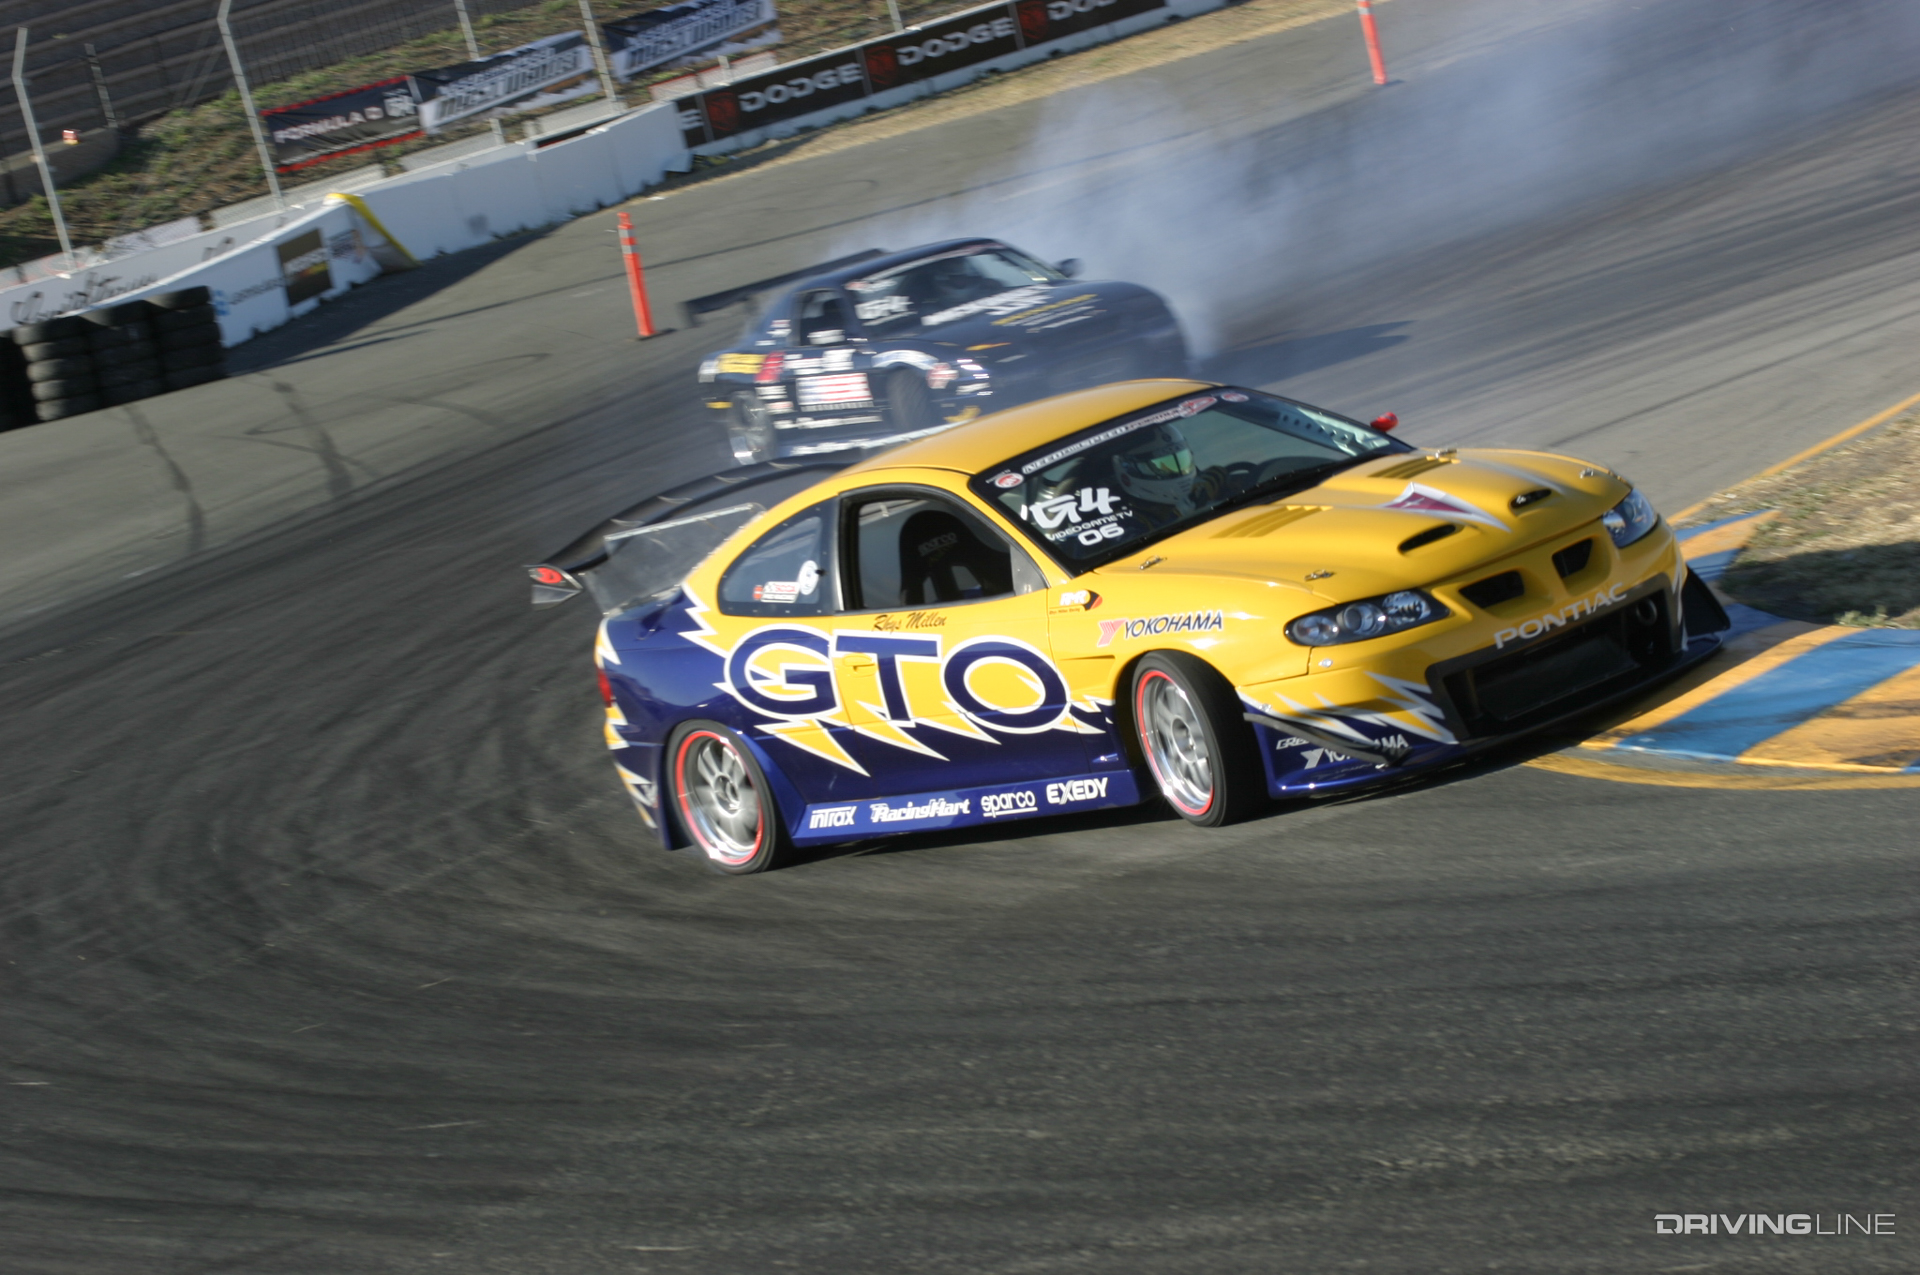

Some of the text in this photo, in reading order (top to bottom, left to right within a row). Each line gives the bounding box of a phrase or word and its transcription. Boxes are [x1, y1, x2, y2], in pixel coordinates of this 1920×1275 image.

[896, 16, 1017, 67] DODGE
[738, 62, 863, 113] DODGE
[1029, 487, 1121, 529] G4
[1077, 523, 1125, 546] 06
[871, 611, 947, 635] Rhys Millen
[1124, 610, 1223, 639] YOKOHAMA
[1493, 582, 1627, 650] PONTIAC
[724, 623, 1071, 735] GTO
[981, 790, 1037, 818] sparco
[1046, 777, 1108, 805] EXEDY
